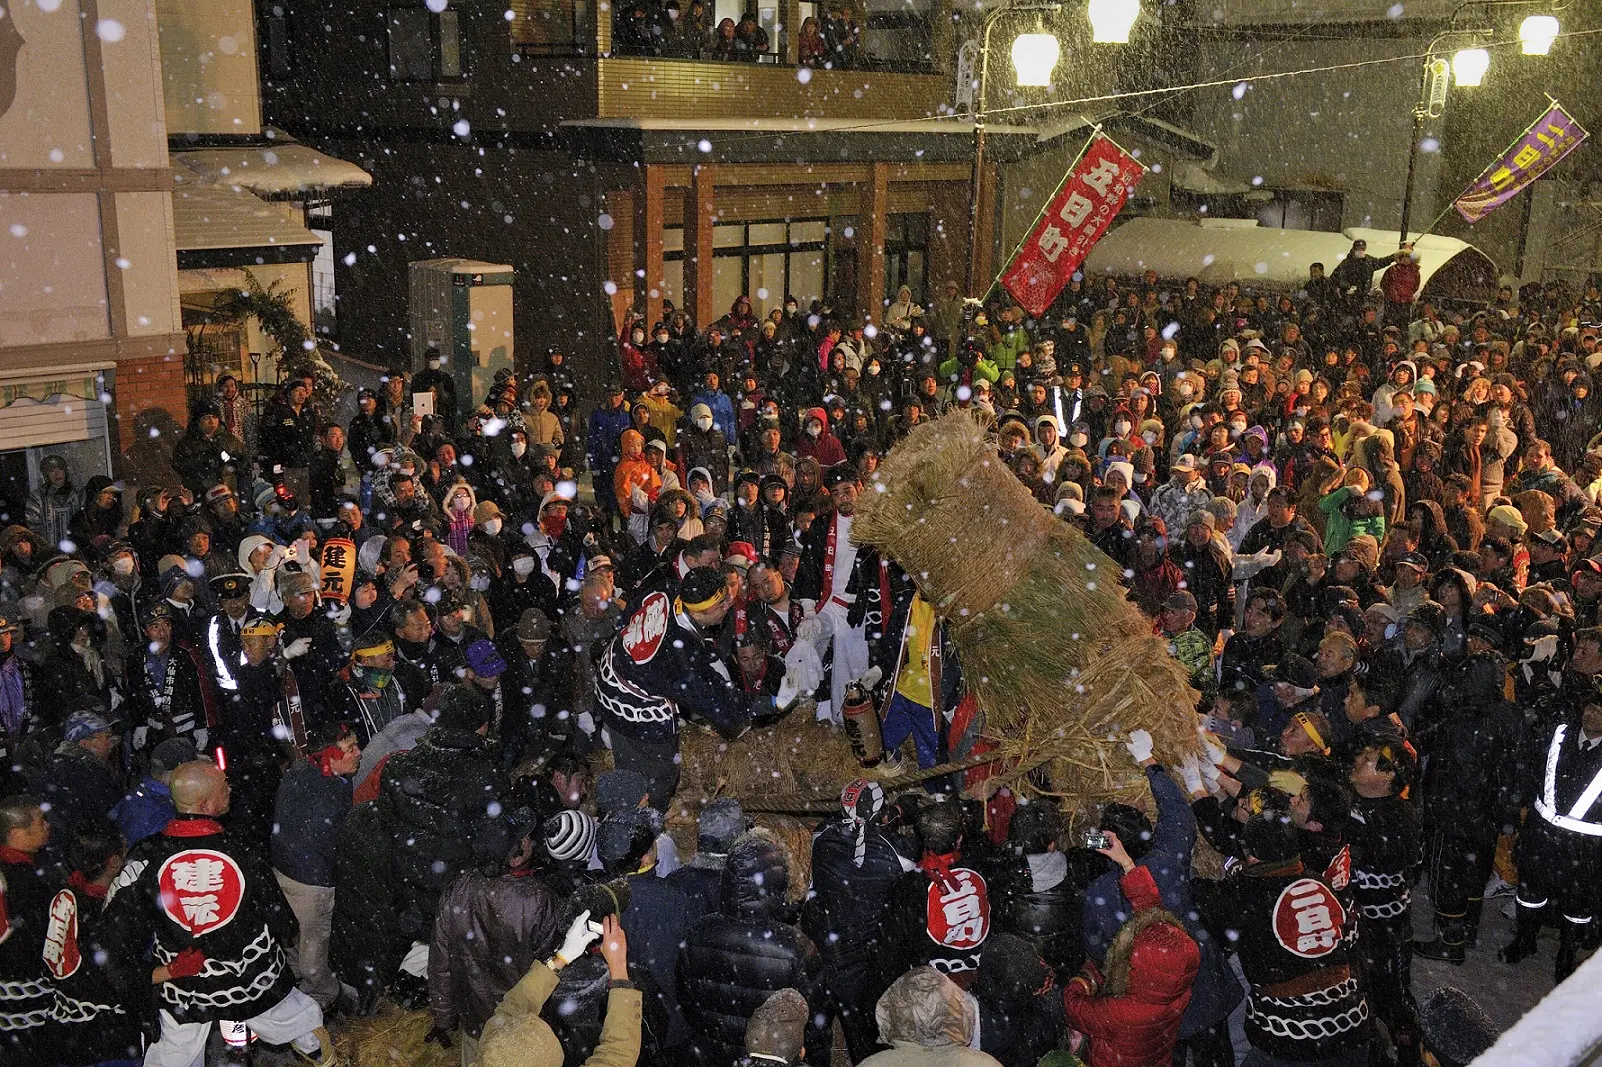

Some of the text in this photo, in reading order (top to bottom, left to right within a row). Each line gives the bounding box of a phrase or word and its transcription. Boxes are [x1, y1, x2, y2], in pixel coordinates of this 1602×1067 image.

[1489, 124, 1565, 192] 二日町
[1038, 157, 1120, 263] 五日町
[1069, 168, 1135, 257] 刈和野の大綱引き
[321, 546, 347, 593] 建元
[931, 645, 940, 657] 元
[290, 703, 301, 714] 元
[1290, 882, 1337, 952] 二日町
